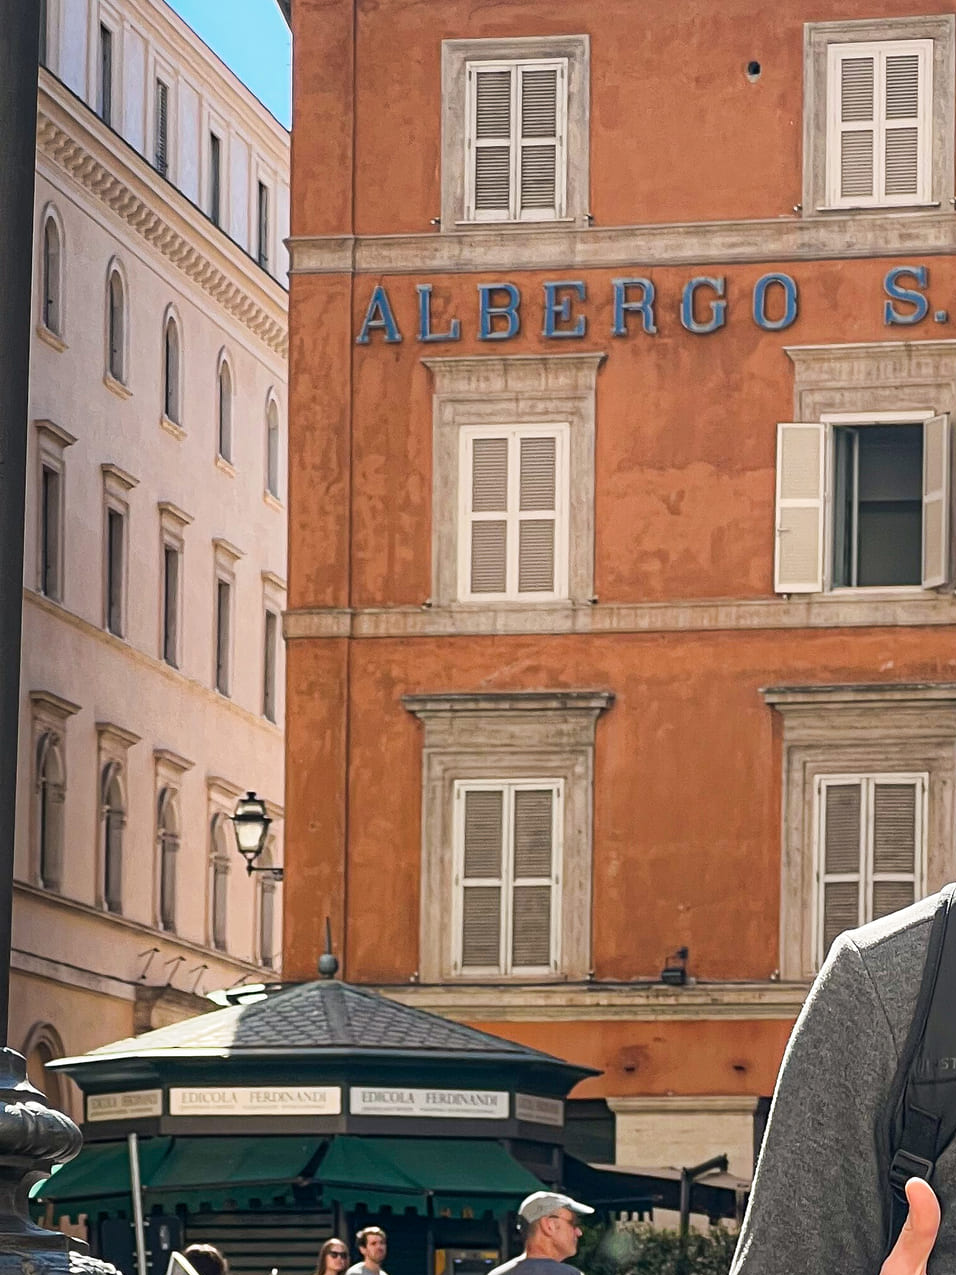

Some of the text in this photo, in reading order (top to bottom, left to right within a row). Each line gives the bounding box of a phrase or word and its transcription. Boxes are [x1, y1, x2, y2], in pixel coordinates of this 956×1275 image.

[356, 272, 800, 343] ALBERGO
[883, 265, 947, 325] S.
[181, 1091, 238, 1104] EDICOLA
[361, 1091, 415, 1104] EDICOLA
